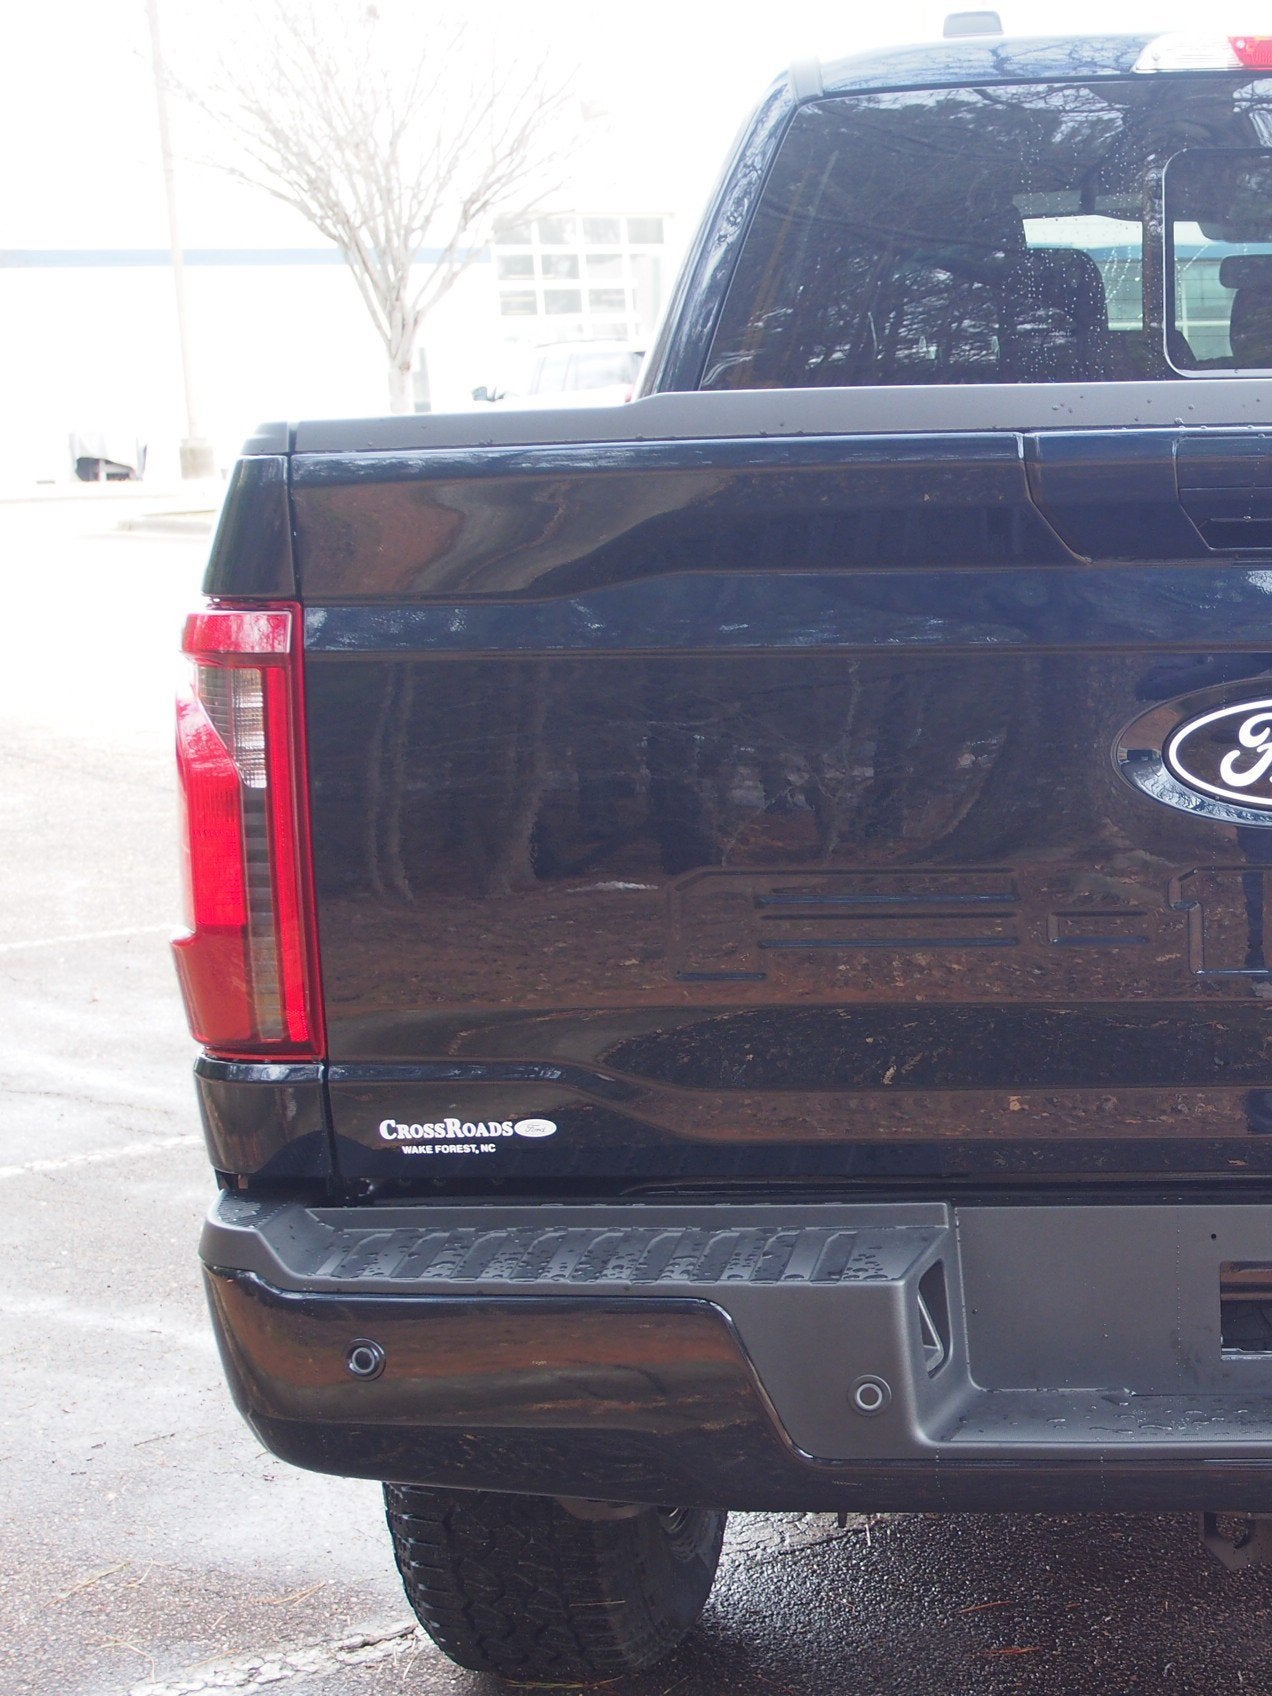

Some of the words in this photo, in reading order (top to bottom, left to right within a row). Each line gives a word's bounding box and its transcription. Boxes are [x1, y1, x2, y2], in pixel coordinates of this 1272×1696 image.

[402, 1145, 434, 1155] WAKE
[434, 1144, 480, 1155] FOREST,
[481, 1143, 497, 1153] NC
